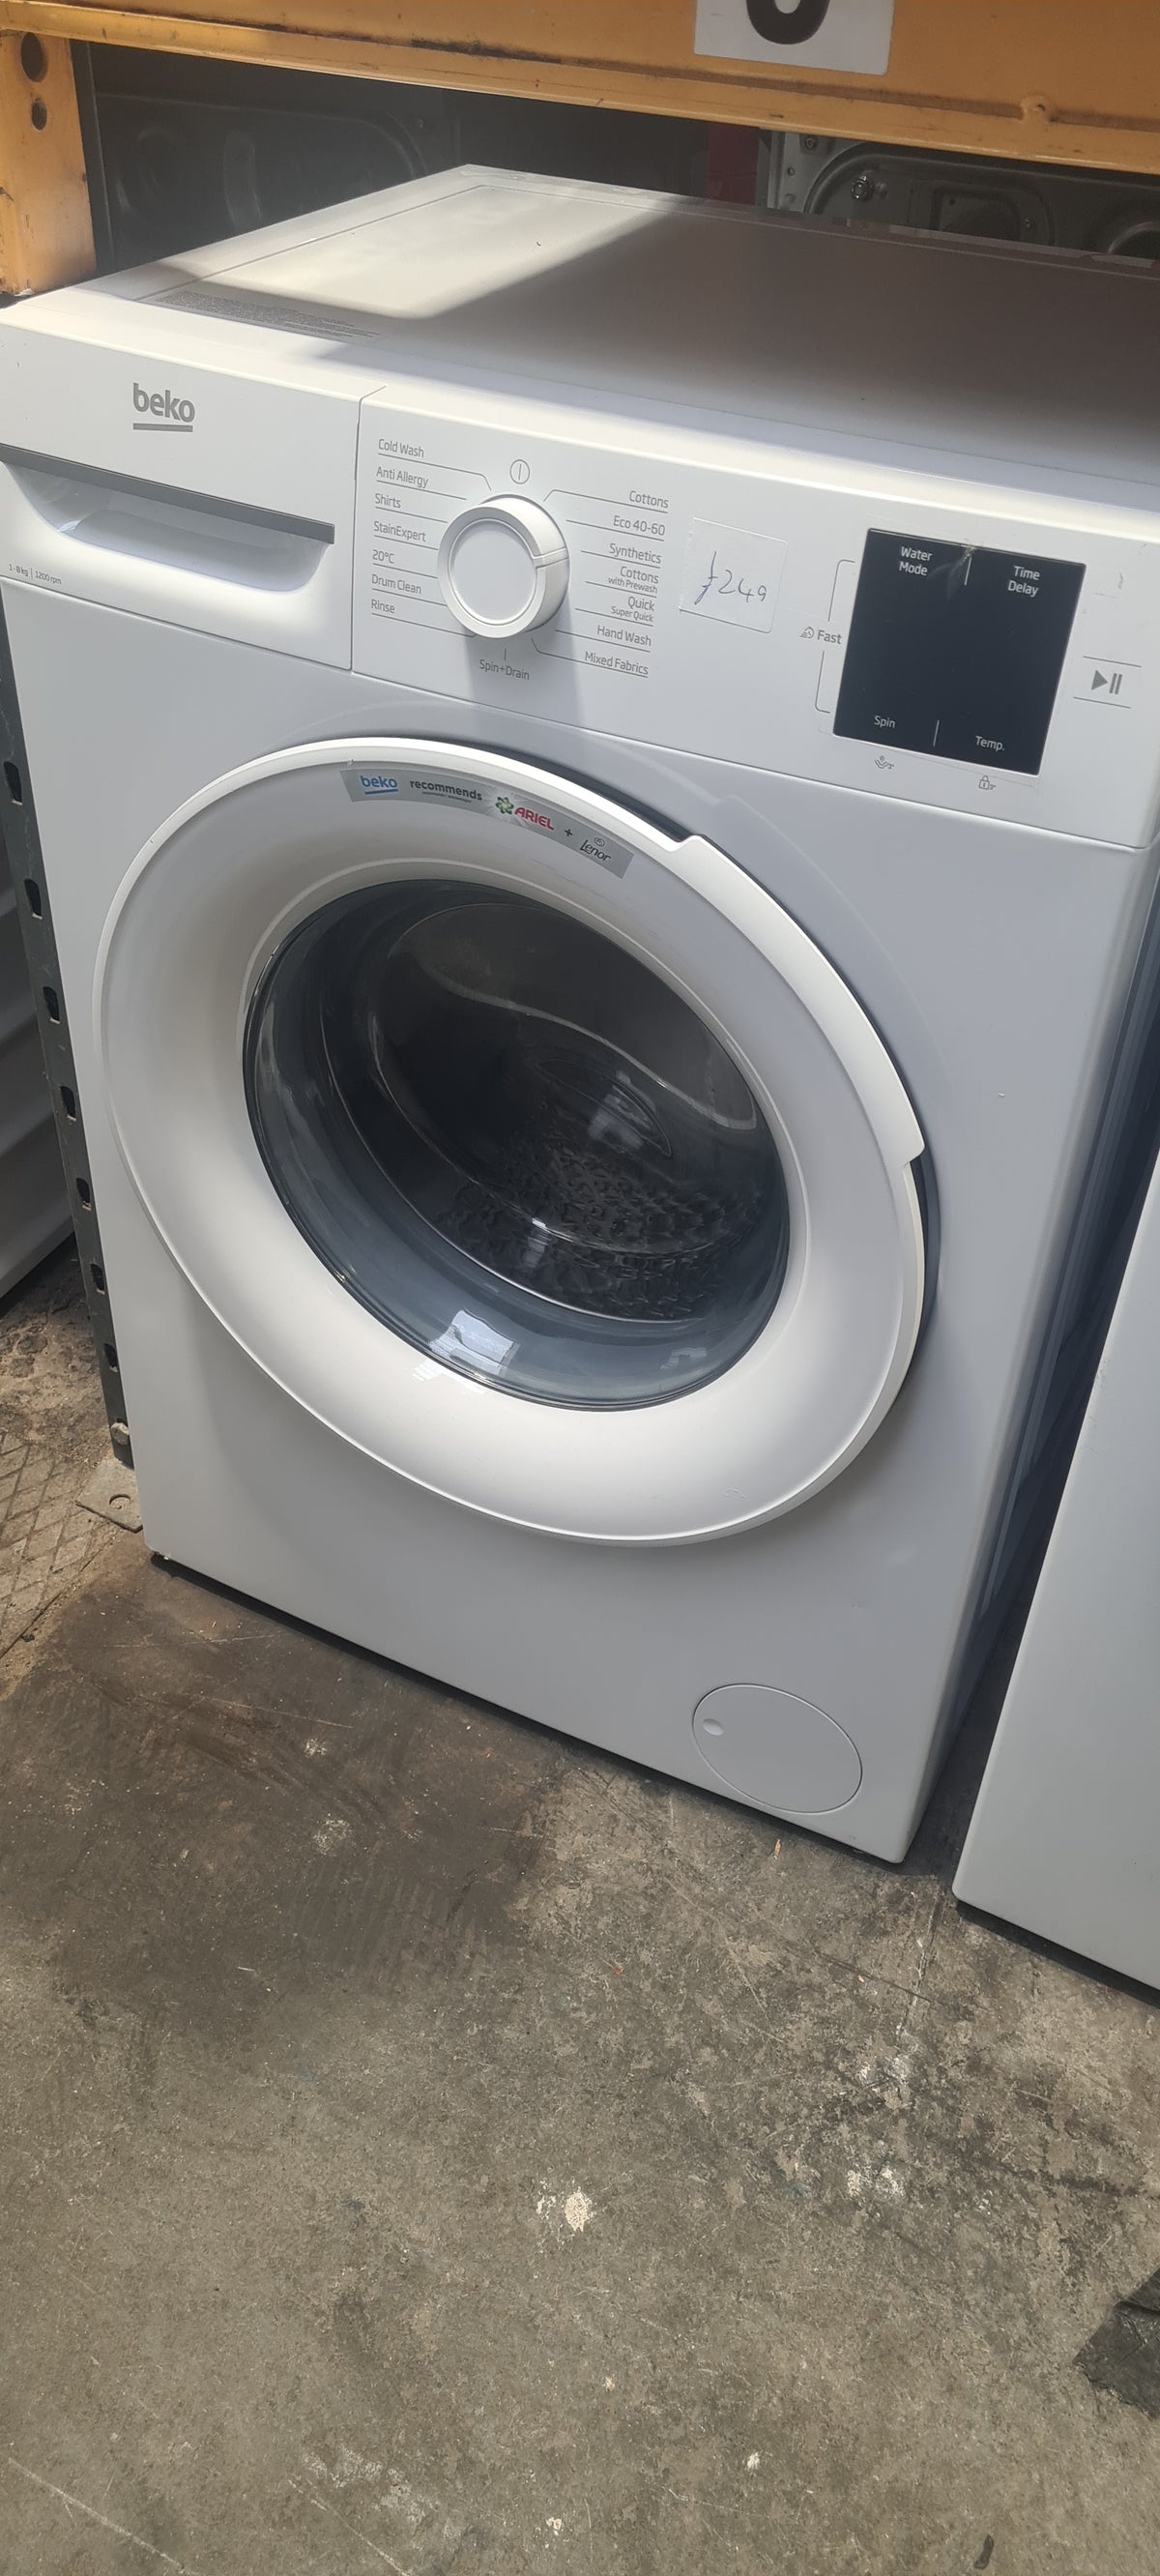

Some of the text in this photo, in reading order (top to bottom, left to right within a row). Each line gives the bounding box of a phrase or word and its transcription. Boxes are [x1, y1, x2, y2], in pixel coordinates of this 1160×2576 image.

[133, 383, 195, 423] beko
[378, 438, 424, 458] Cold Wash
[376, 466, 429, 488] Anti Allergy
[375, 493, 401, 509] Shirts
[629, 490, 669, 509] Cottons
[373, 520, 426, 542] StainExpert
[613, 514, 666, 537] Eco 40-60
[372, 549, 394, 565] 20°C
[609, 542, 662, 564] Synthetics
[900, 546, 933, 563] Water
[620, 567, 659, 584] Cottons
[694, 550, 767, 605] £249
[899, 562, 928, 576] Mode
[1013, 565, 1040, 580] Time
[371, 574, 421, 595] Drum Clean
[608, 576, 657, 595] with Prewash
[1007, 580, 1039, 597] Delay
[371, 599, 395, 614] Rinse
[627, 596, 655, 612] Quick
[611, 605, 654, 624] Super Quick
[596, 625, 652, 647] Hand Wash
[817, 629, 842, 645] Fast
[479, 659, 530, 681] Spin+Drain
[585, 651, 649, 675] Mixed Fabrics
[874, 715, 896, 730] Spin
[975, 735, 1005, 751] Temp.
[361, 776, 398, 789] beko
[410, 780, 482, 801] recommends
[514, 806, 555, 831] ARIEL
[580, 839, 612, 863] Lenor
